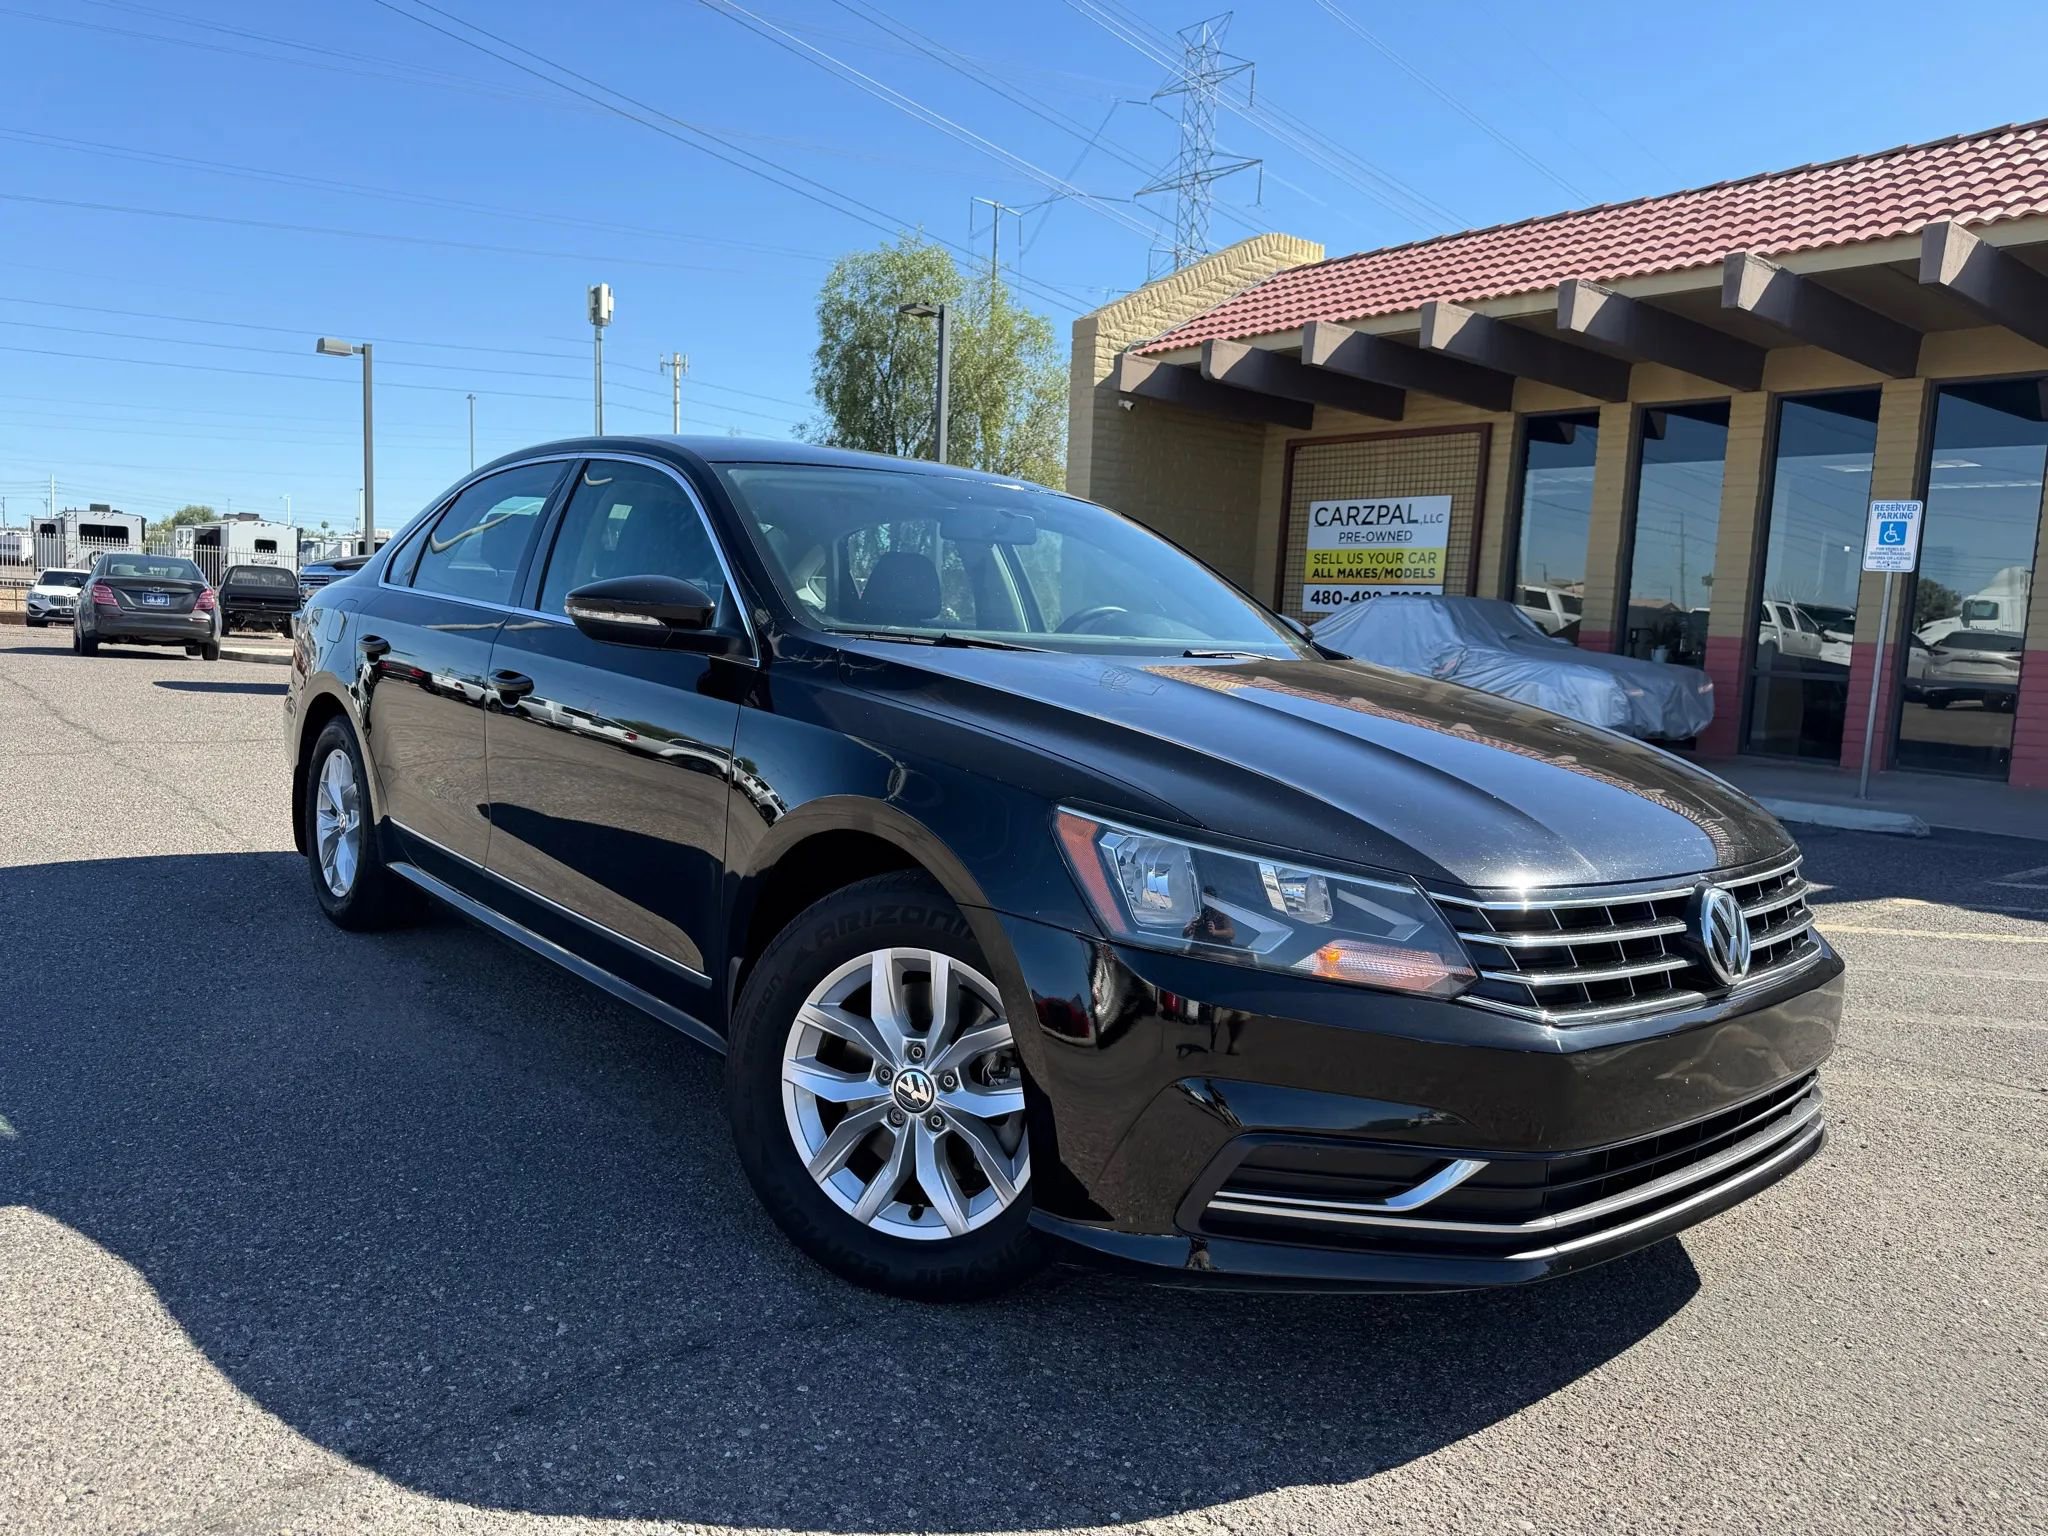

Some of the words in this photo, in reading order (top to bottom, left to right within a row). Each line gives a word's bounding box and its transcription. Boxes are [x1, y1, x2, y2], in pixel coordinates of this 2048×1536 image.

[1314, 504, 1418, 526] CARZPAL
[1338, 530, 1413, 545] PRE-OWNED
[1313, 553, 1344, 565] SELL
[1347, 553, 1364, 565] US
[1368, 552, 1404, 565] YOUR
[1408, 551, 1437, 565] CAR
[1312, 568, 1334, 579] ALL
[1336, 567, 1436, 580] MAKES/MODELS
